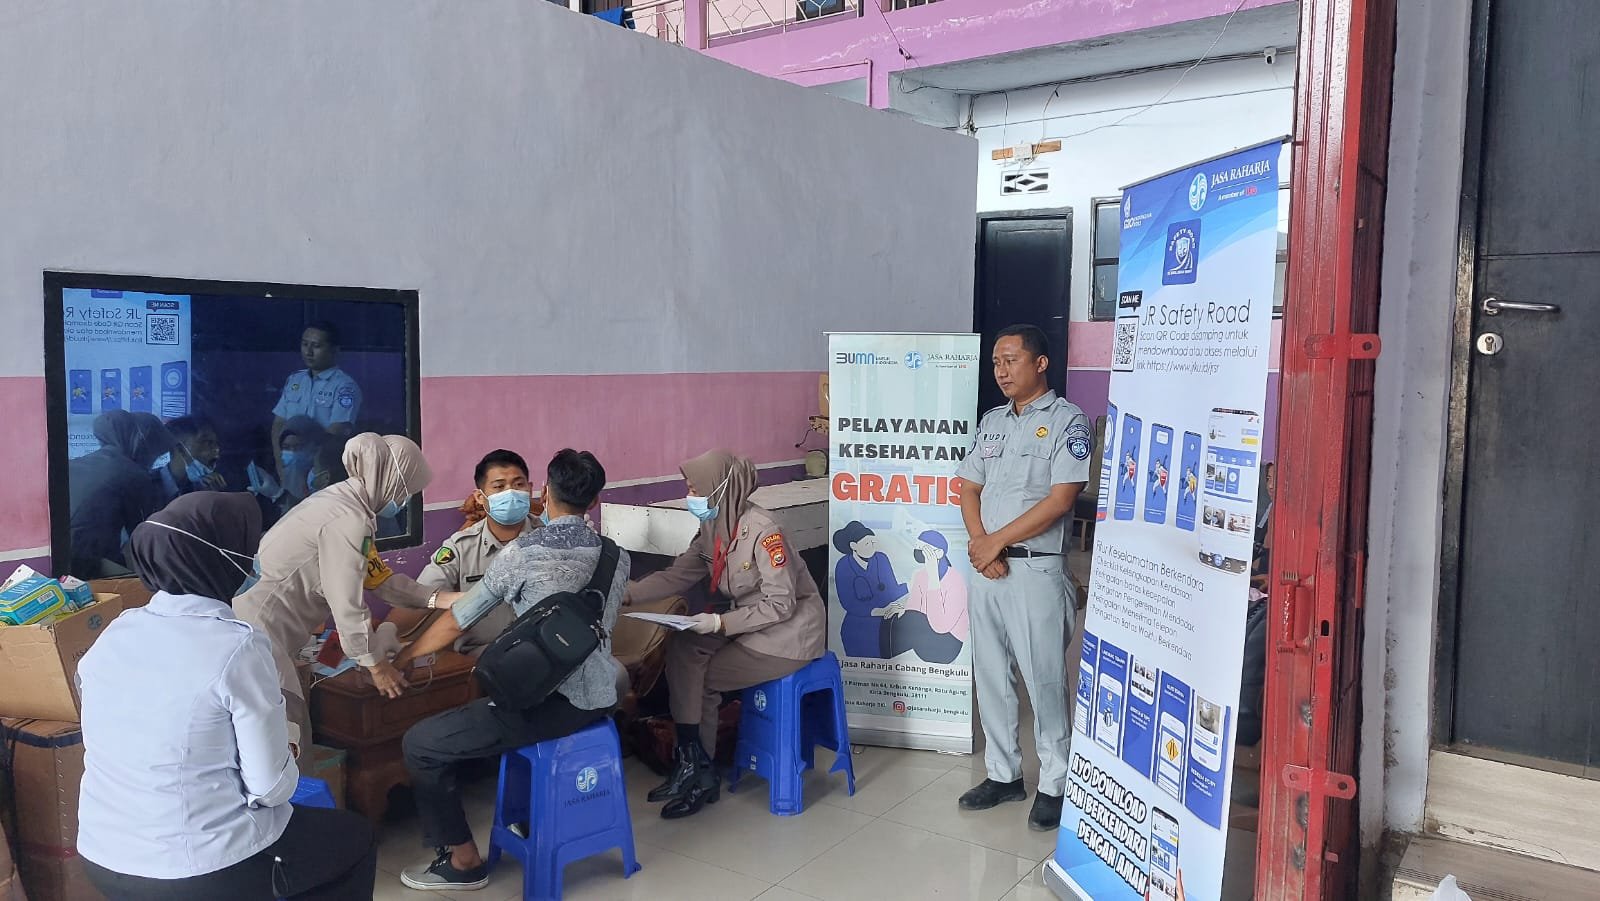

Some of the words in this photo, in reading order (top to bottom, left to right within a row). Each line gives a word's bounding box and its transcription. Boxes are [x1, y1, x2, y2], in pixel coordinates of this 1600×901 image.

[1211, 169, 1228, 188] JASA
[1230, 159, 1270, 180] RAHARJA
[1121, 295, 1131, 304] SCAN
[1132, 294, 1140, 303] ME
[1142, 305, 1156, 326] JR
[1160, 303, 1204, 329] Safety
[1207, 299, 1251, 323] Road
[1140, 330, 1155, 341] Scan
[1156, 330, 1168, 341] QR
[1169, 330, 1189, 341] Code
[1225, 329, 1249, 340] untuk
[928, 353, 943, 361] JASA
[1224, 345, 1259, 358] melalui
[838, 417, 968, 434] PELAYANAN
[839, 443, 966, 461] KESEHATAN
[831, 471, 963, 506] GRATIS
[1109, 544, 1159, 573] Keselamatan
[1160, 562, 1204, 592] Berkendara
[841, 660, 858, 669] Jasa
[860, 661, 893, 671] Raharja
[895, 663, 927, 674] Cabang
[928, 666, 969, 677] Bengkulu
[1071, 752, 1092, 783] AYO
[1091, 766, 1147, 824] DOWNLOAD
[1066, 777, 1086, 810] DAN
[1085, 792, 1147, 863] BERKENDARA
[1077, 818, 1118, 869] DENGAN
[1115, 851, 1148, 897] AMAN
